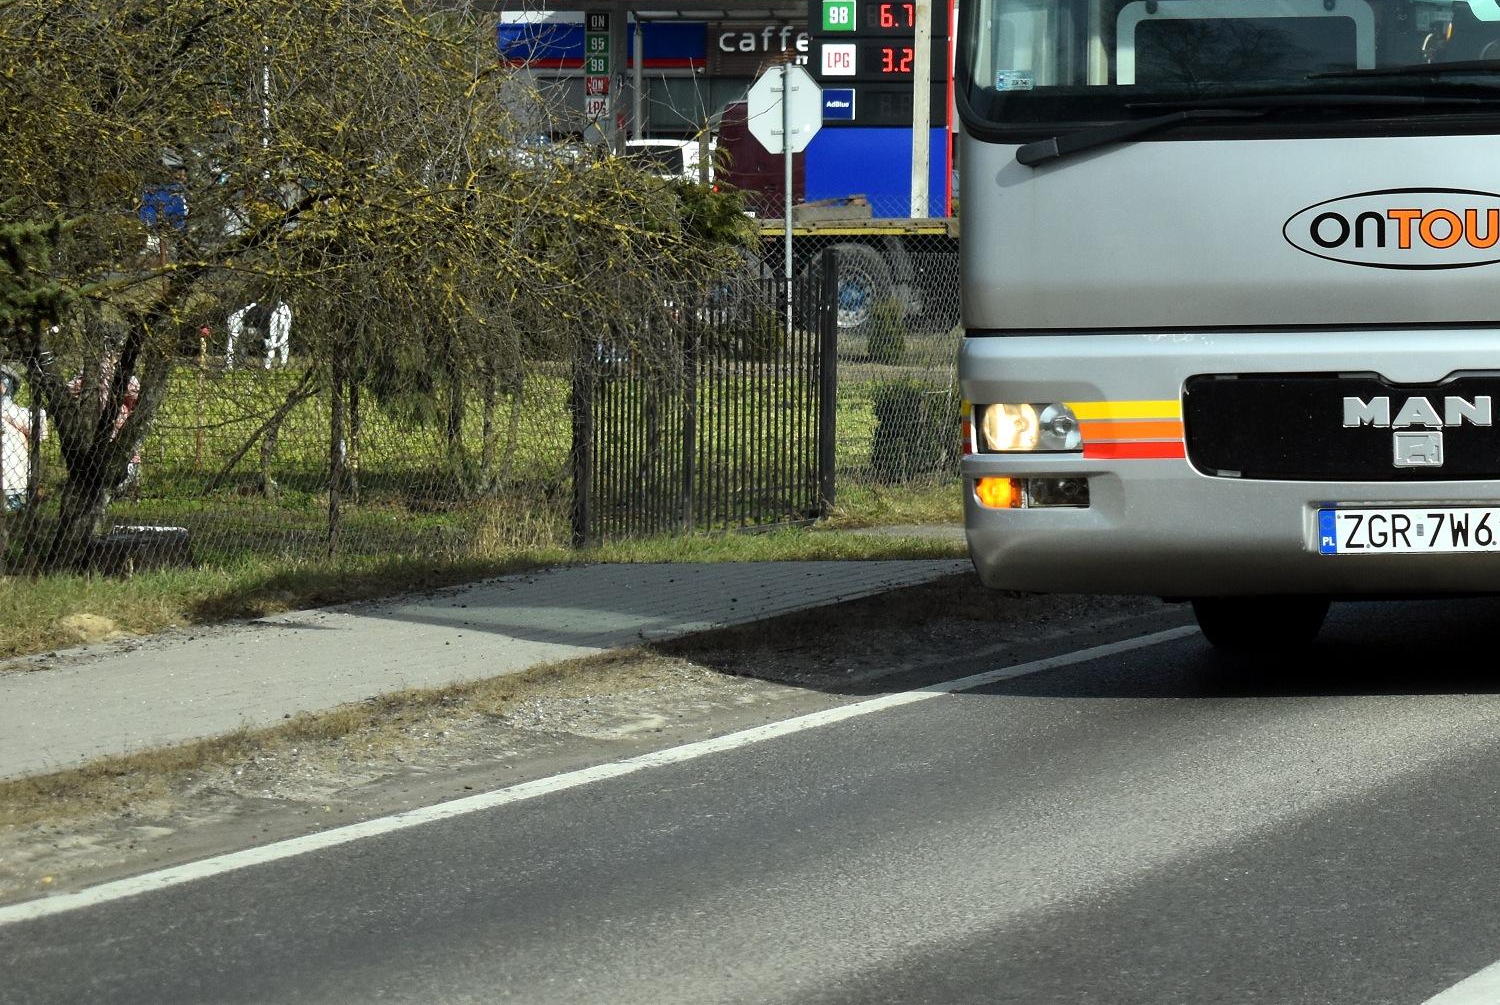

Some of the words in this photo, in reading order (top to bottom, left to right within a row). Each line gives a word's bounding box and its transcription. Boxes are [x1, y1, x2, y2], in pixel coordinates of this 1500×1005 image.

[591, 15, 605, 28] ON
[829, 6, 849, 24] 98
[880, 4, 914, 28] 6.7
[591, 37, 605, 51] 95
[591, 59, 605, 72] 98
[827, 52, 850, 68] LPG
[881, 48, 914, 73] 3.2
[826, 99, 850, 109] AdBlue
[1343, 396, 1493, 430] MAN
[1344, 514, 1412, 549] ZGR
[1322, 536, 1336, 547] PL
